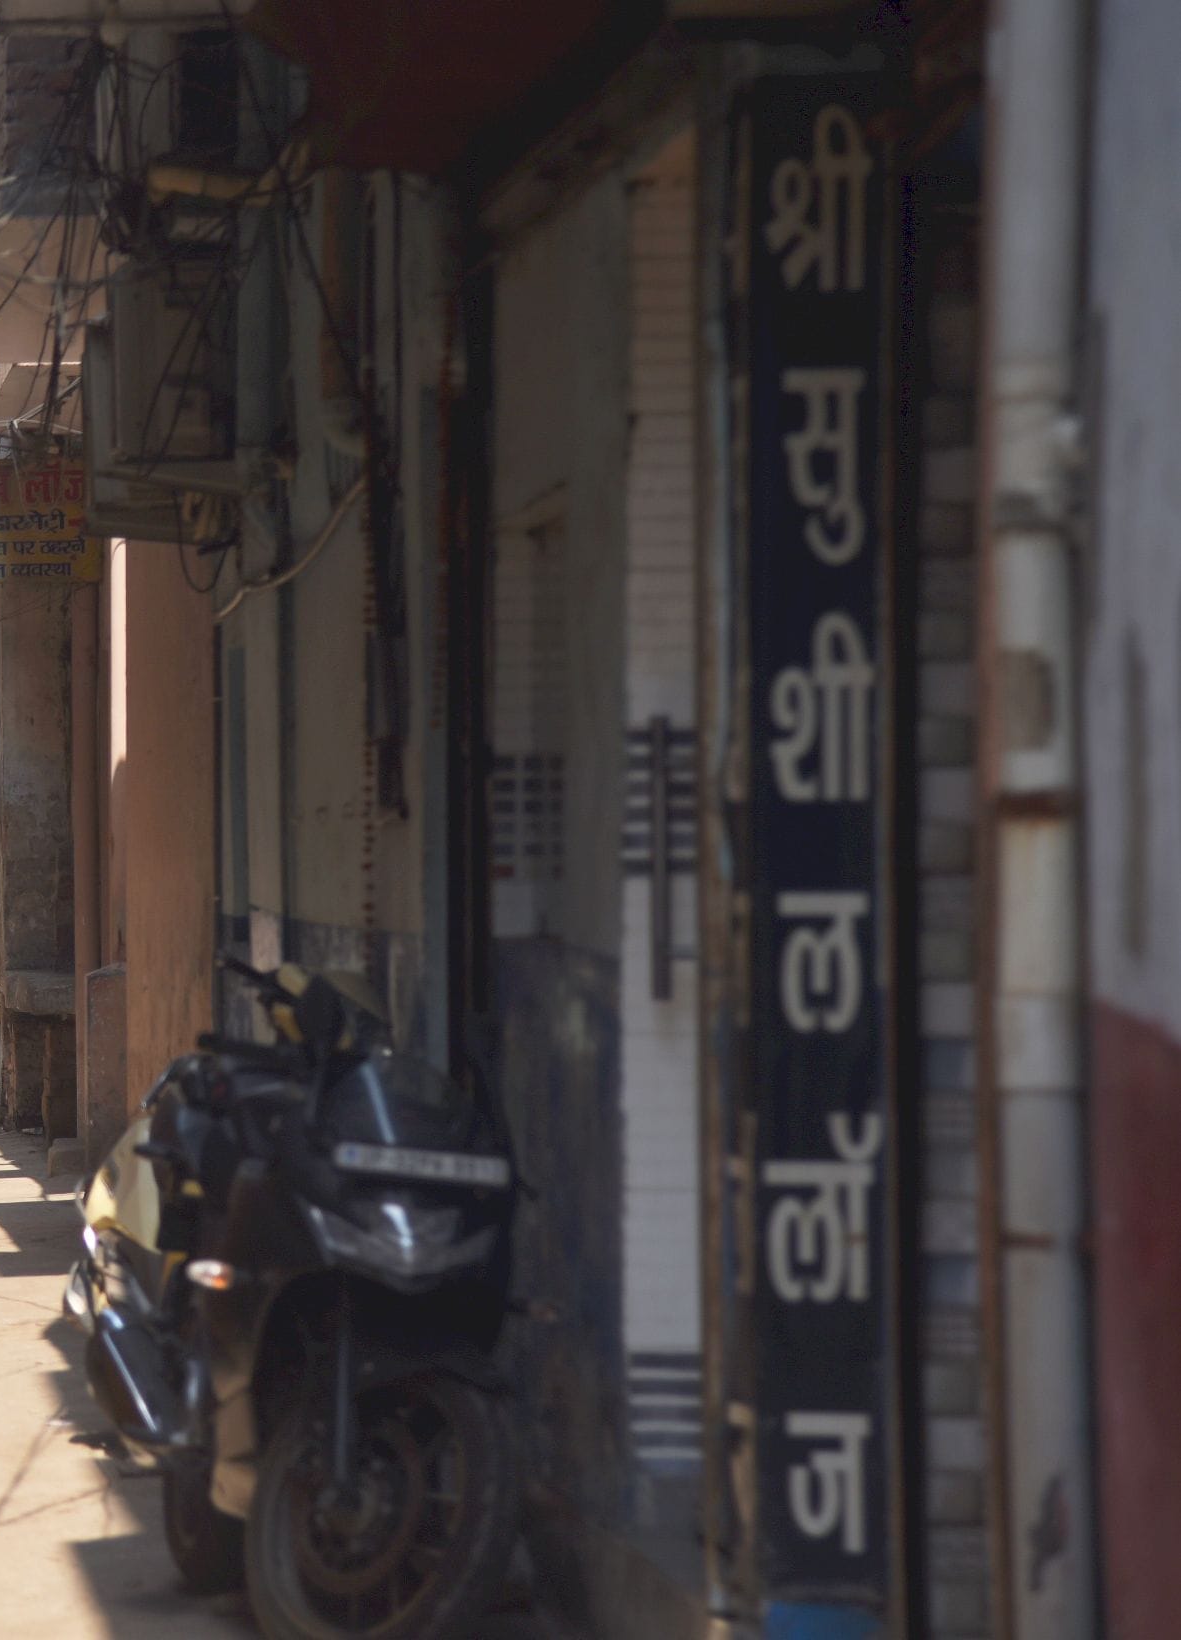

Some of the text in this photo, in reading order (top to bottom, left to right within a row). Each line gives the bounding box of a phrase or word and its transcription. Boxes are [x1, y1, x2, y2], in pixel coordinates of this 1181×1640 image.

[765, 103, 872, 292] श्री
[11, 562, 71, 578] व्यवस्था
[13, 540, 35, 556] पर
[764, 1112, 883, 1554] लॉज
